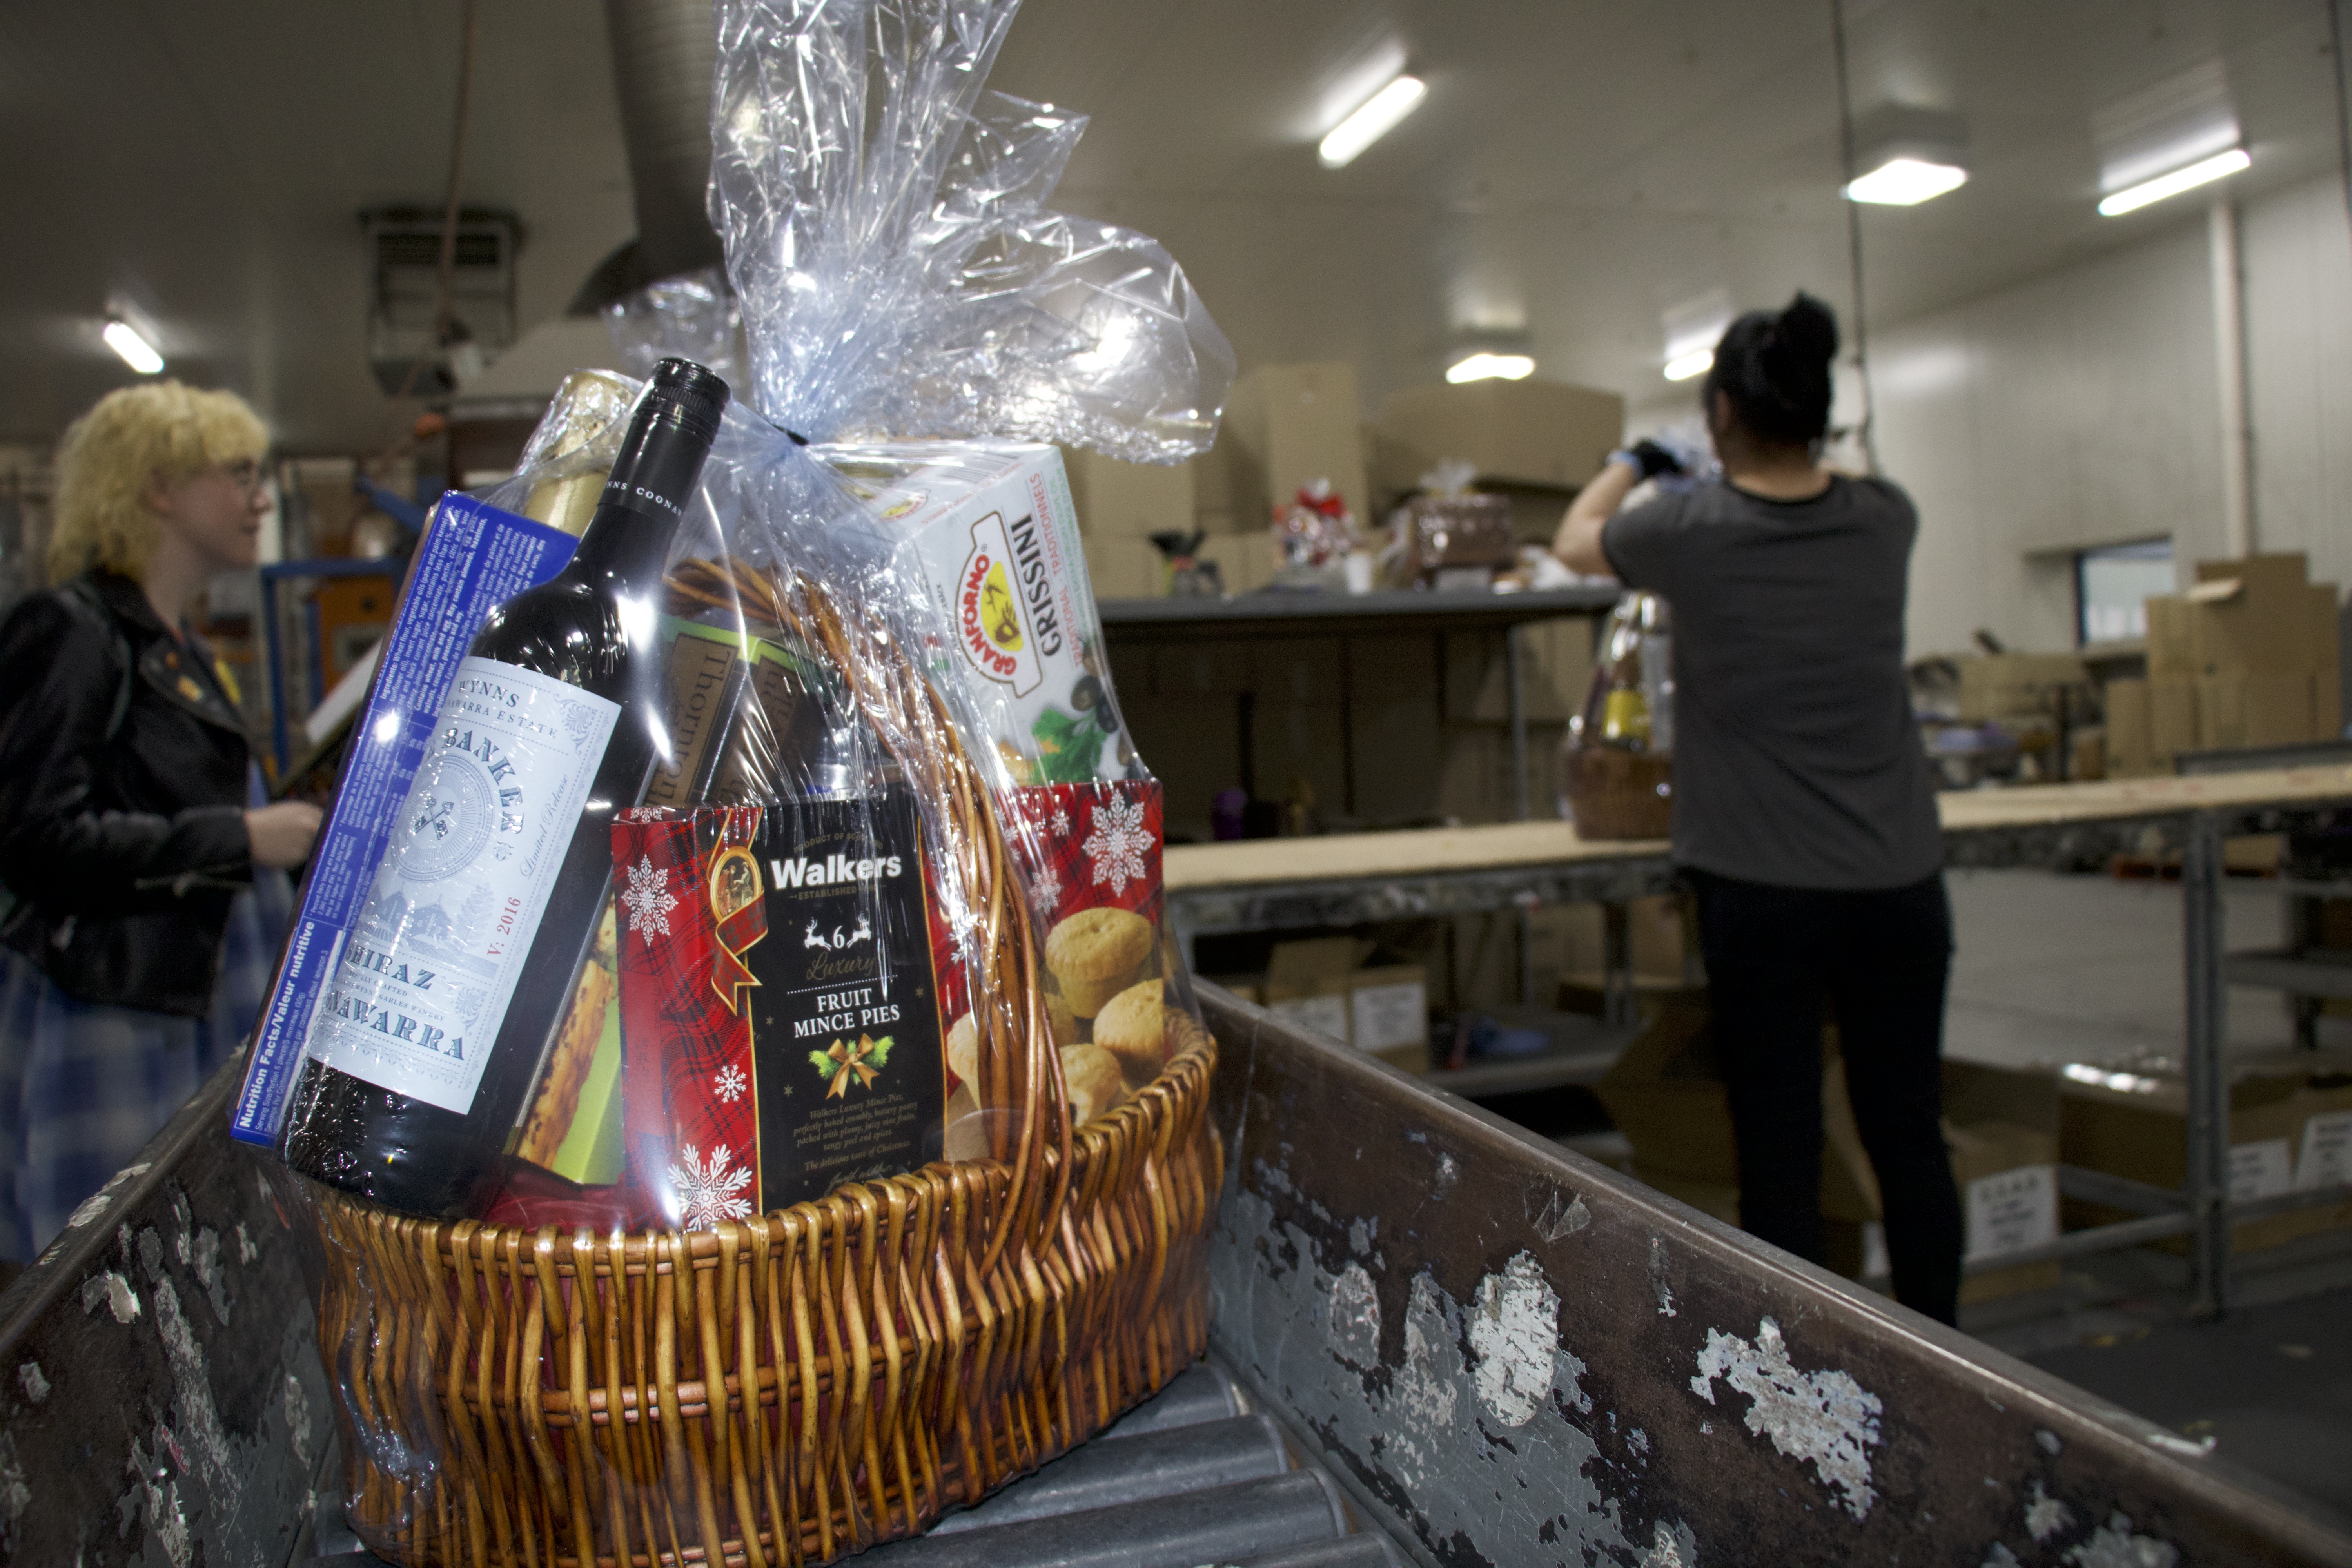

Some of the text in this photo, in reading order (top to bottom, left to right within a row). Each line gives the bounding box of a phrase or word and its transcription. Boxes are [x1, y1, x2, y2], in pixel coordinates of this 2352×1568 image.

[1030, 473, 1062, 575] TRADITIONNELS
[485, 572, 497, 590] sucre,
[492, 547, 506, 571] contient
[502, 527, 513, 545] moins
[518, 561, 528, 575] Peut
[523, 536, 537, 561] contenir
[537, 540, 546, 551] des
[527, 570, 534, 578] de
[530, 553, 541, 568] coco,
[393, 642, 404, 661] Wheat
[401, 625, 411, 639] flour,
[406, 595, 422, 625] vegetable
[422, 566, 432, 583] (palm
[432, 538, 441, 552] palm
[437, 518, 448, 537] kernel
[494, 577, 505, 594] rouge
[1011, 513, 1062, 657] GRISSINI
[402, 680, 410, 692] and
[407, 662, 416, 678] black
[413, 639, 425, 660] currant
[421, 622, 431, 637] juice
[427, 583, 445, 620] concentrate,
[441, 561, 453, 581] pectin,
[448, 543, 458, 558] citric
[455, 526, 465, 541] acid,
[461, 511, 470, 524] sour
[414, 517, 487, 710] Contains wheat, milk and egg. May contain almonds, hazelnuts,
[445, 661, 456, 679] Farine
[452, 652, 459, 660] de
[459, 619, 470, 637] huiles
[487, 540, 501, 559] palme
[497, 524, 505, 532] de
[964, 555, 1017, 675] GRANFORNO
[388, 672, 404, 702] sunflower
[405, 640, 415, 657] invert
[412, 620, 423, 639] sugar,
[419, 599, 430, 618] sugar,
[425, 572, 438, 598] contains
[434, 559, 443, 571] less
[439, 544, 448, 557] than
[444, 532, 452, 541] 1%
[423, 610, 465, 713] walnuts, coconut, peanuts and soy.
[459, 680, 519, 707] WYNNS
[497, 710, 557, 738] ESTATE
[441, 728, 524, 834] BANKER
[520, 774, 568, 880] Limited Release
[794, 833, 831, 853] PRODUCT
[770, 854, 901, 890] Walkers
[799, 886, 856, 900] ESTABLISHED
[487, 897, 521, 956] V: 2016
[833, 926, 844, 948] 6
[806, 951, 876, 980] Luxury
[374, 980, 408, 996] CAFTED
[817, 988, 872, 1012] FRUIT
[379, 994, 408, 1009] GABLES
[412, 1005, 445, 1022] WINERY
[794, 1004, 900, 1038] MINCE PIES
[238, 920, 315, 1127] Nutrition Facts/Valeur nutritive
[255, 1107, 269, 1131] Serving
[810, 1109, 837, 1119] Walkers
[840, 1103, 864, 1113] Luxury
[866, 1098, 887, 1107] Mince
[793, 1122, 822, 1137] perfectly
[824, 1117, 843, 1128] baked
[797, 1132, 821, 1148] packed
[823, 1130, 838, 1139] with
[865, 1121, 880, 1132] juicy
[824, 1141, 842, 1151] tangy
[844, 1136, 857, 1148] peel
[859, 1133, 871, 1142] and
[805, 1162, 818, 1171] The
[820, 1156, 849, 1168] delicious
[851, 1151, 866, 1160] taste
[868, 1146, 876, 1158] of
